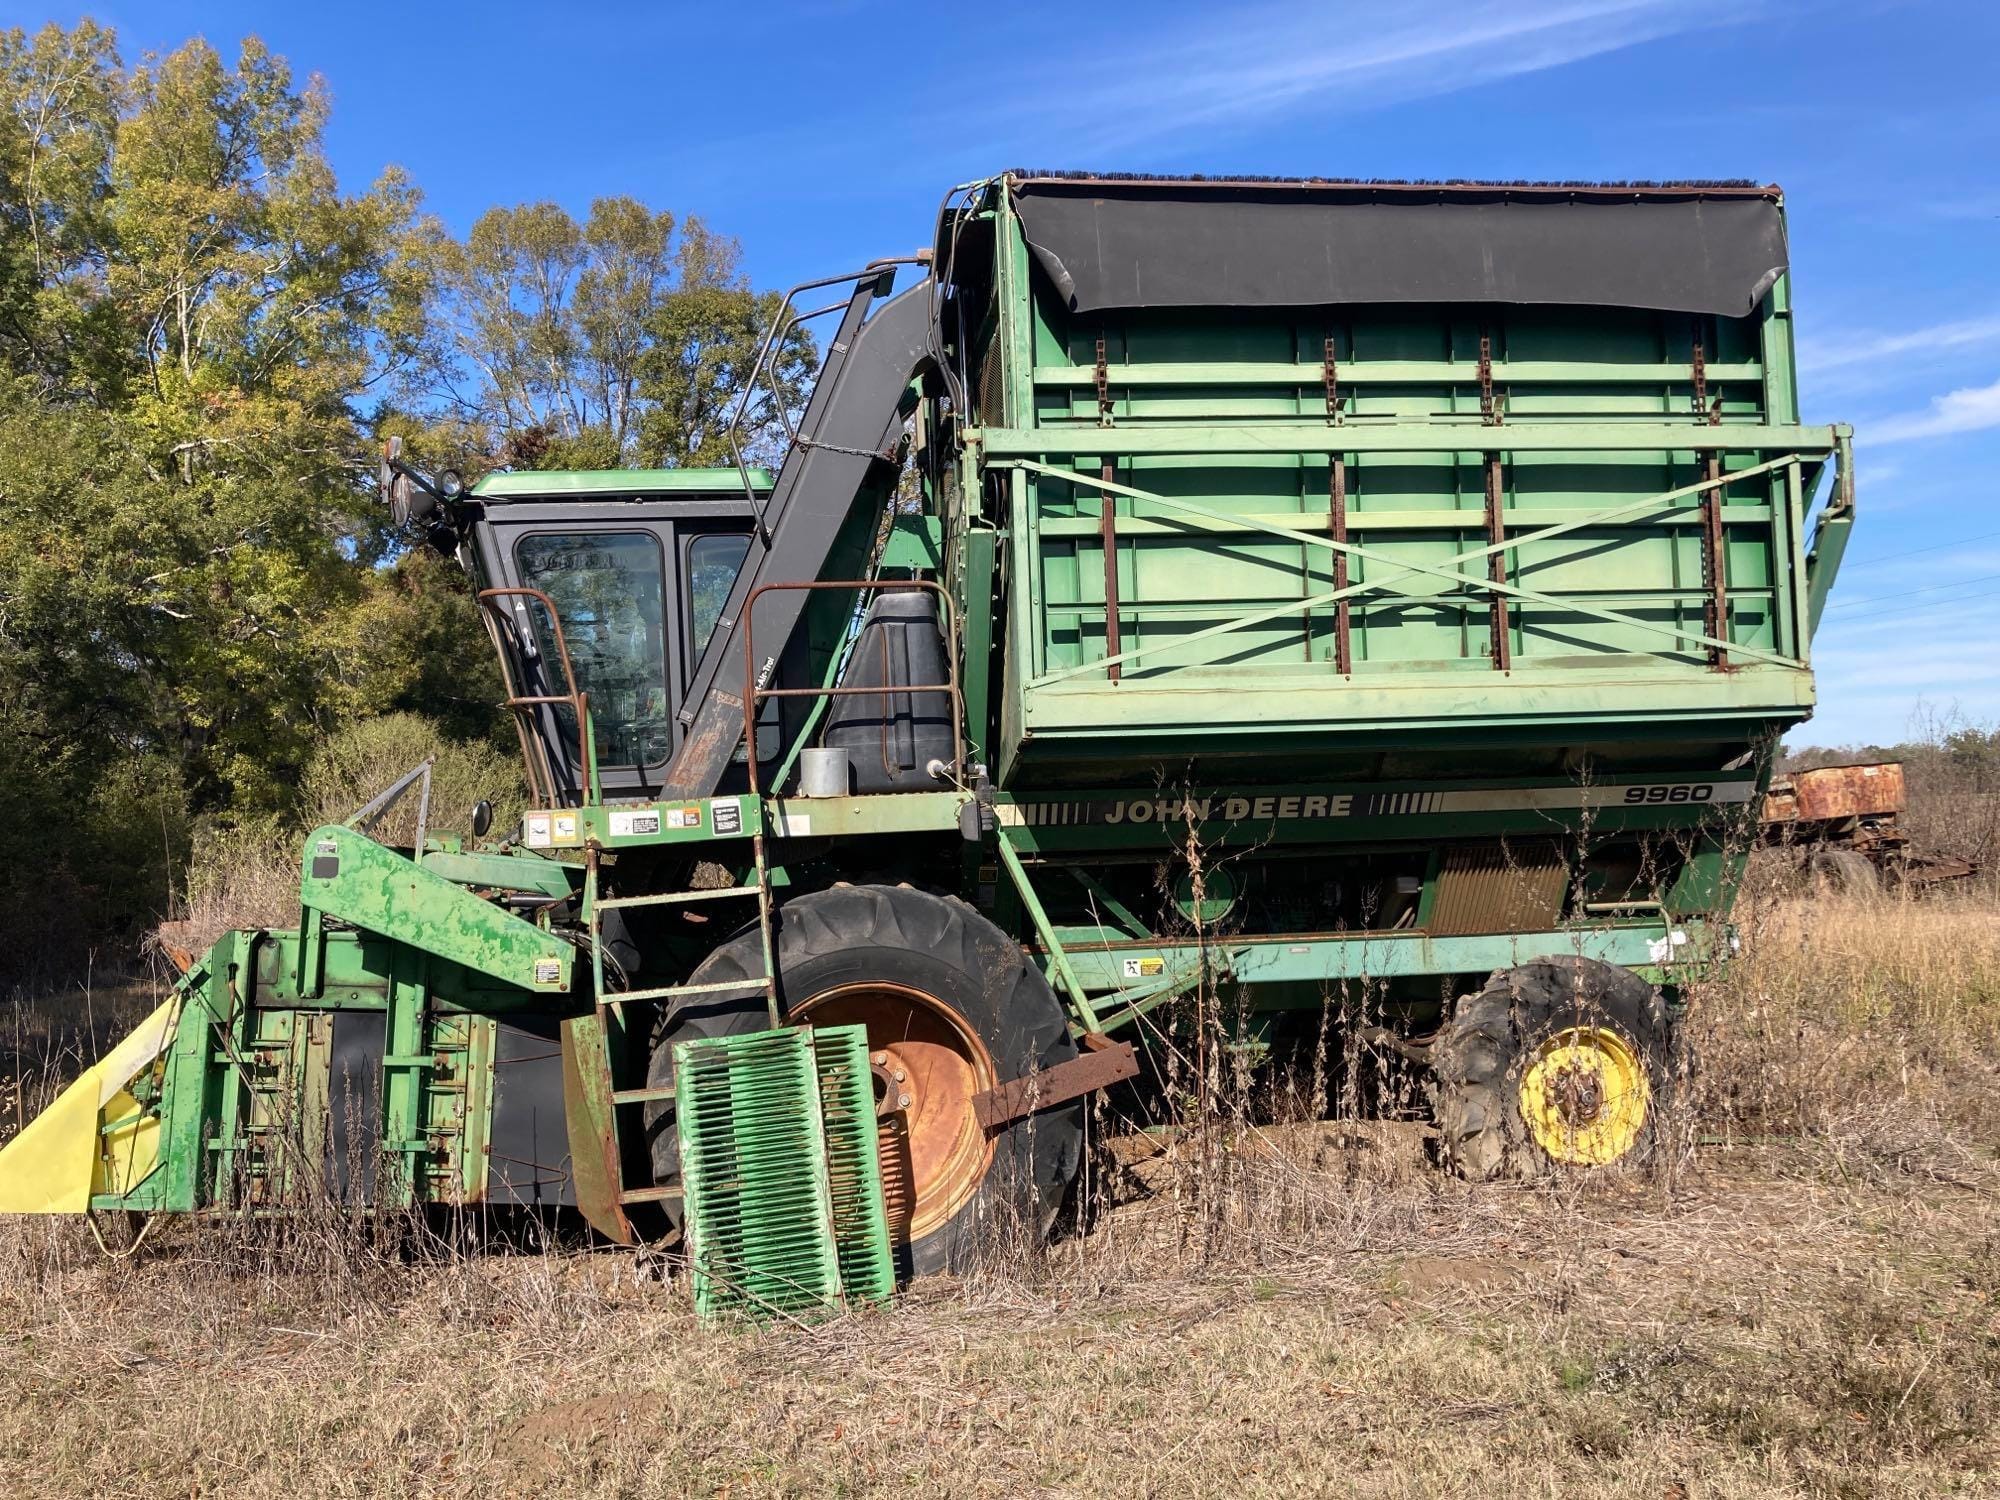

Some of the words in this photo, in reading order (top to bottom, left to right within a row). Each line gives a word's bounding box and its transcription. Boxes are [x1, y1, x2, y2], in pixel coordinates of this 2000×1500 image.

[754, 656, 775, 691] t-Air-Trol
[1623, 785, 1713, 803] 9960
[1104, 798, 1210, 823] JOHN
[1224, 795, 1354, 820] DEERE
